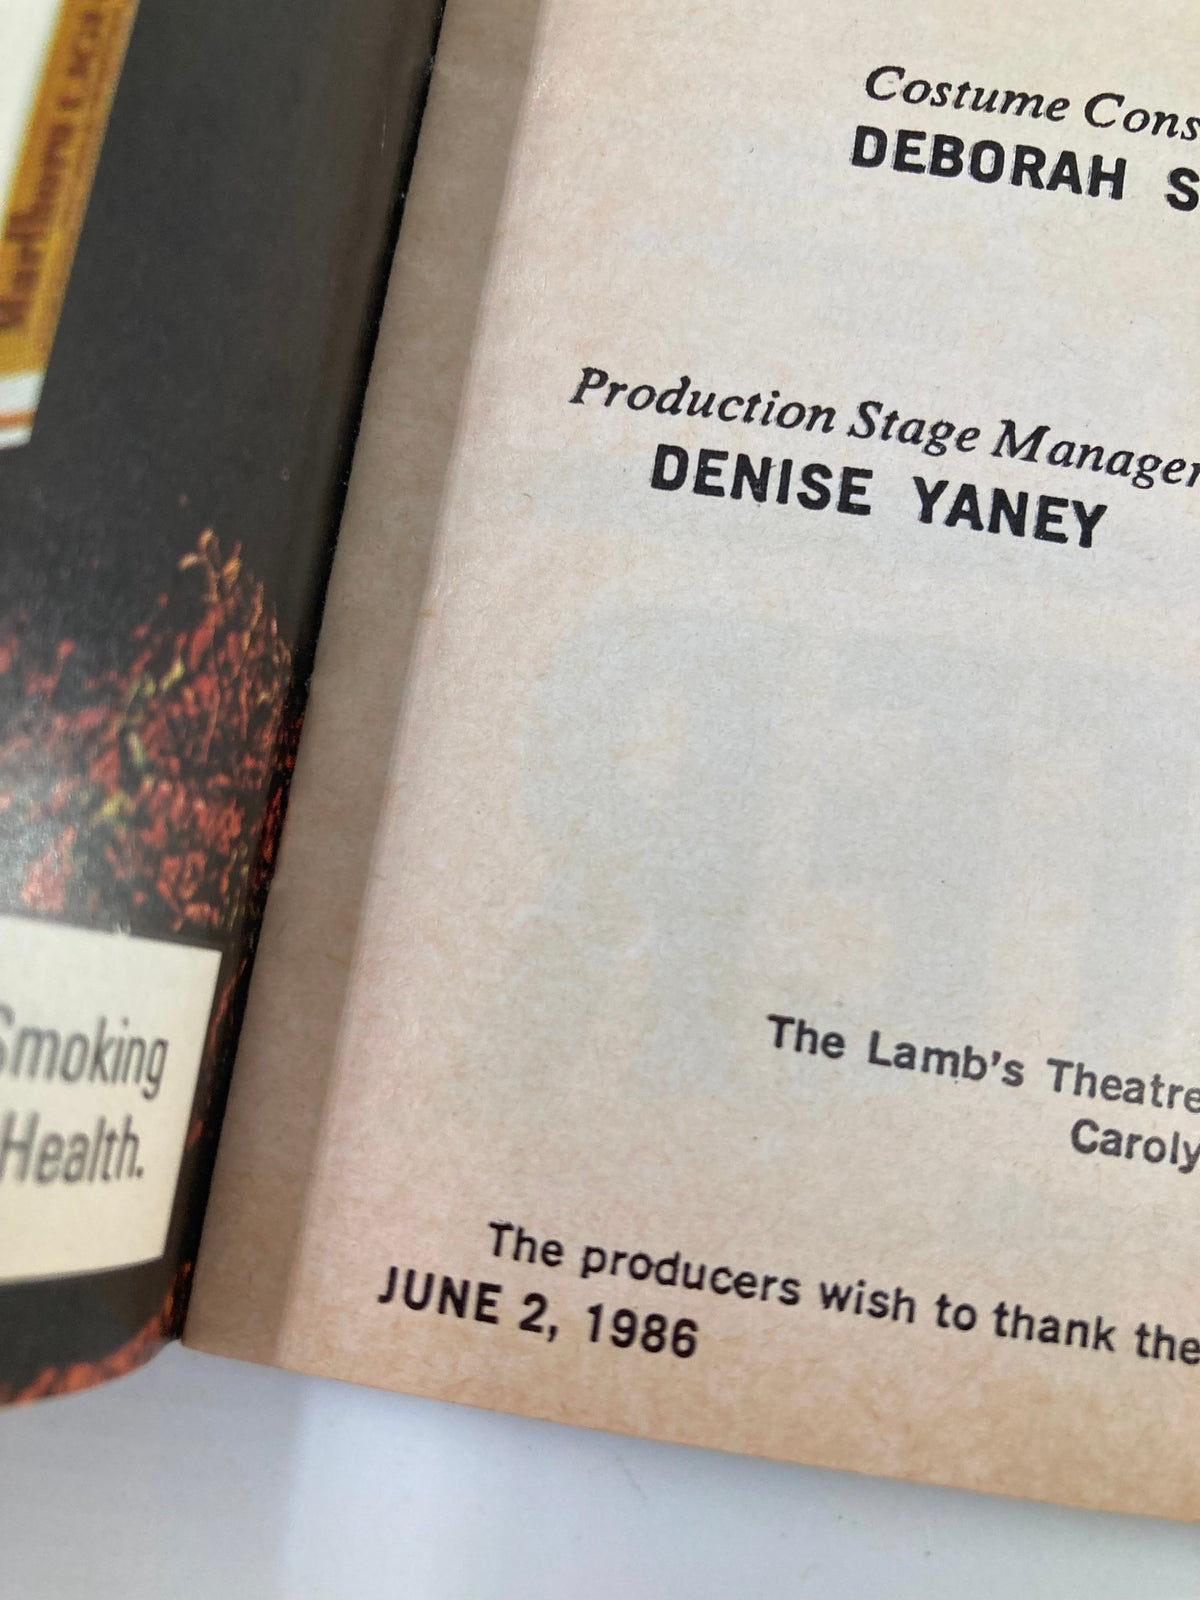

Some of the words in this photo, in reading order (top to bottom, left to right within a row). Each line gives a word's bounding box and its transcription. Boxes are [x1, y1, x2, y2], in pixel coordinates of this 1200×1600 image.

[865, 66, 1070, 122] Costume
[1085, 93, 1200, 141] Cons
[852, 125, 1127, 201] DEBORAH
[1166, 167, 1200, 211] S
[569, 367, 836, 433] Production
[847, 401, 981, 457] Stage
[650, 444, 873, 516] DENISE
[913, 475, 1108, 548] YANEY
[767, 1014, 845, 1059] The
[868, 1031, 1024, 1087] Lamb's
[1047, 1058, 1200, 1113] Theatre
[0, 1111, 144, 1185] Health.
[1071, 1118, 1200, 1174] Caroly
[378, 1266, 502, 1324] JUNE
[519, 1293, 557, 1342] 2,
[588, 1304, 698, 1359] 1986
[487, 1222, 564, 1268] The
[579, 1246, 800, 1306] producers
[820, 1280, 915, 1324] wish
[935, 1293, 977, 1331] to
[993, 1302, 1115, 1351] thank
[1135, 1322, 1200, 1364] the
